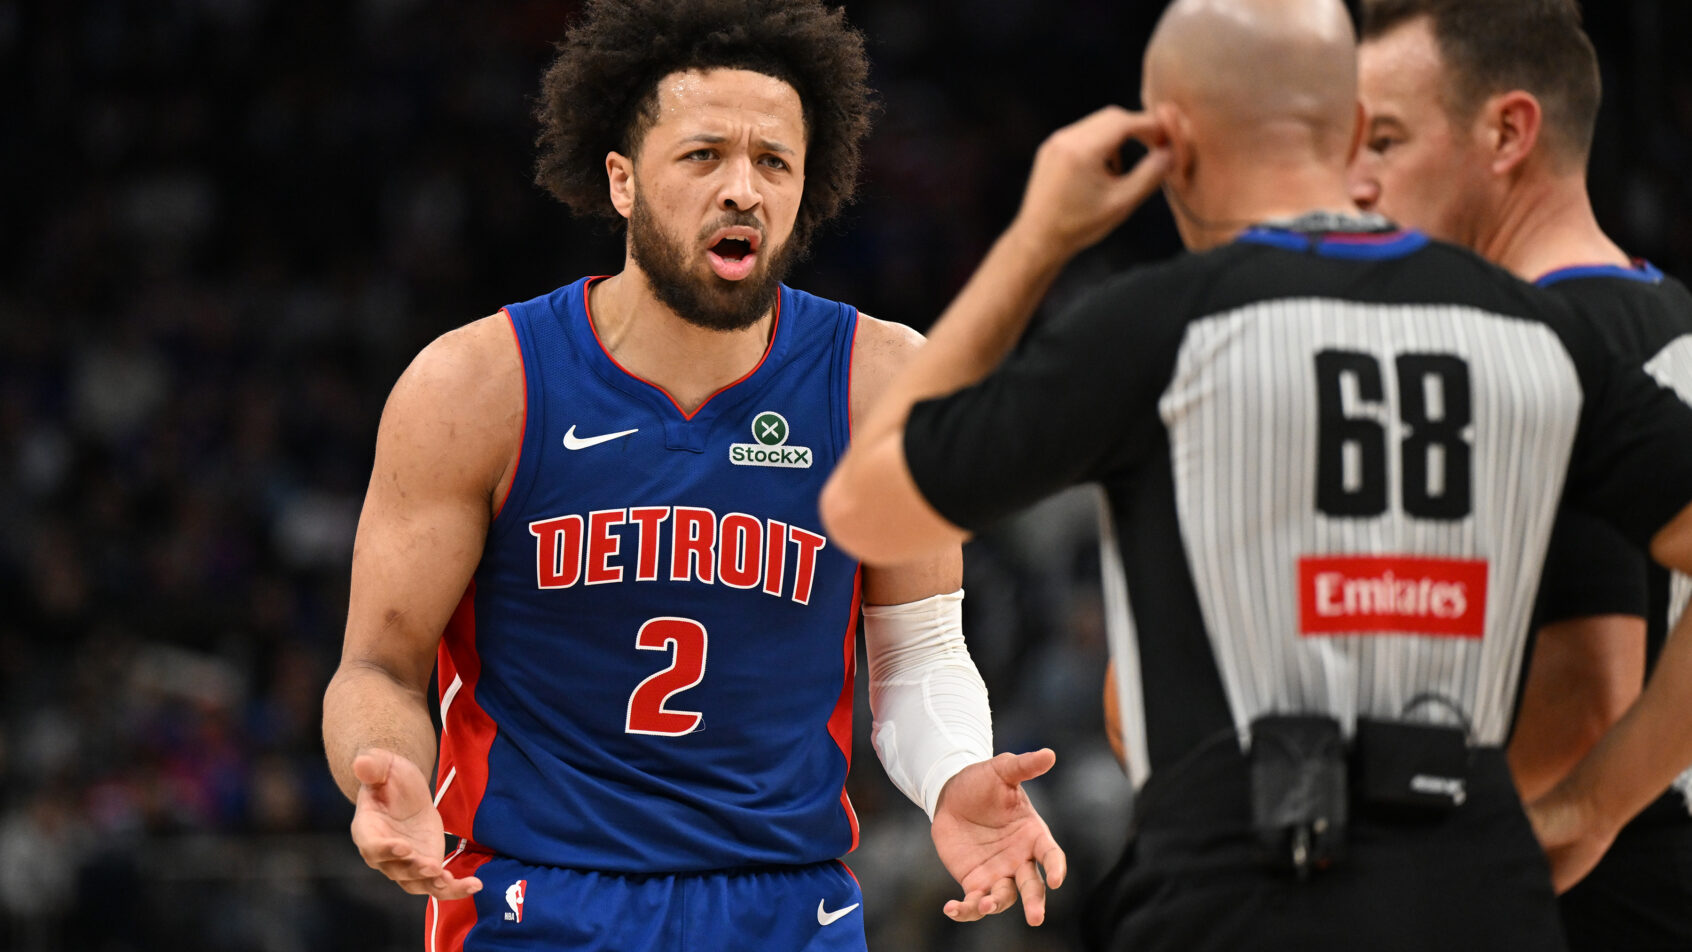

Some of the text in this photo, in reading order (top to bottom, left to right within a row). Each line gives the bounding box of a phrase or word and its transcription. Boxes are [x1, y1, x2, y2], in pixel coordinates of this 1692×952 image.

[732, 446, 809, 464] StockX
[1314, 347, 1472, 521] 68
[528, 505, 827, 605] DETROIT
[1314, 570, 1468, 619] Emirates
[625, 616, 708, 736] 2
[504, 912, 515, 921] NBA
